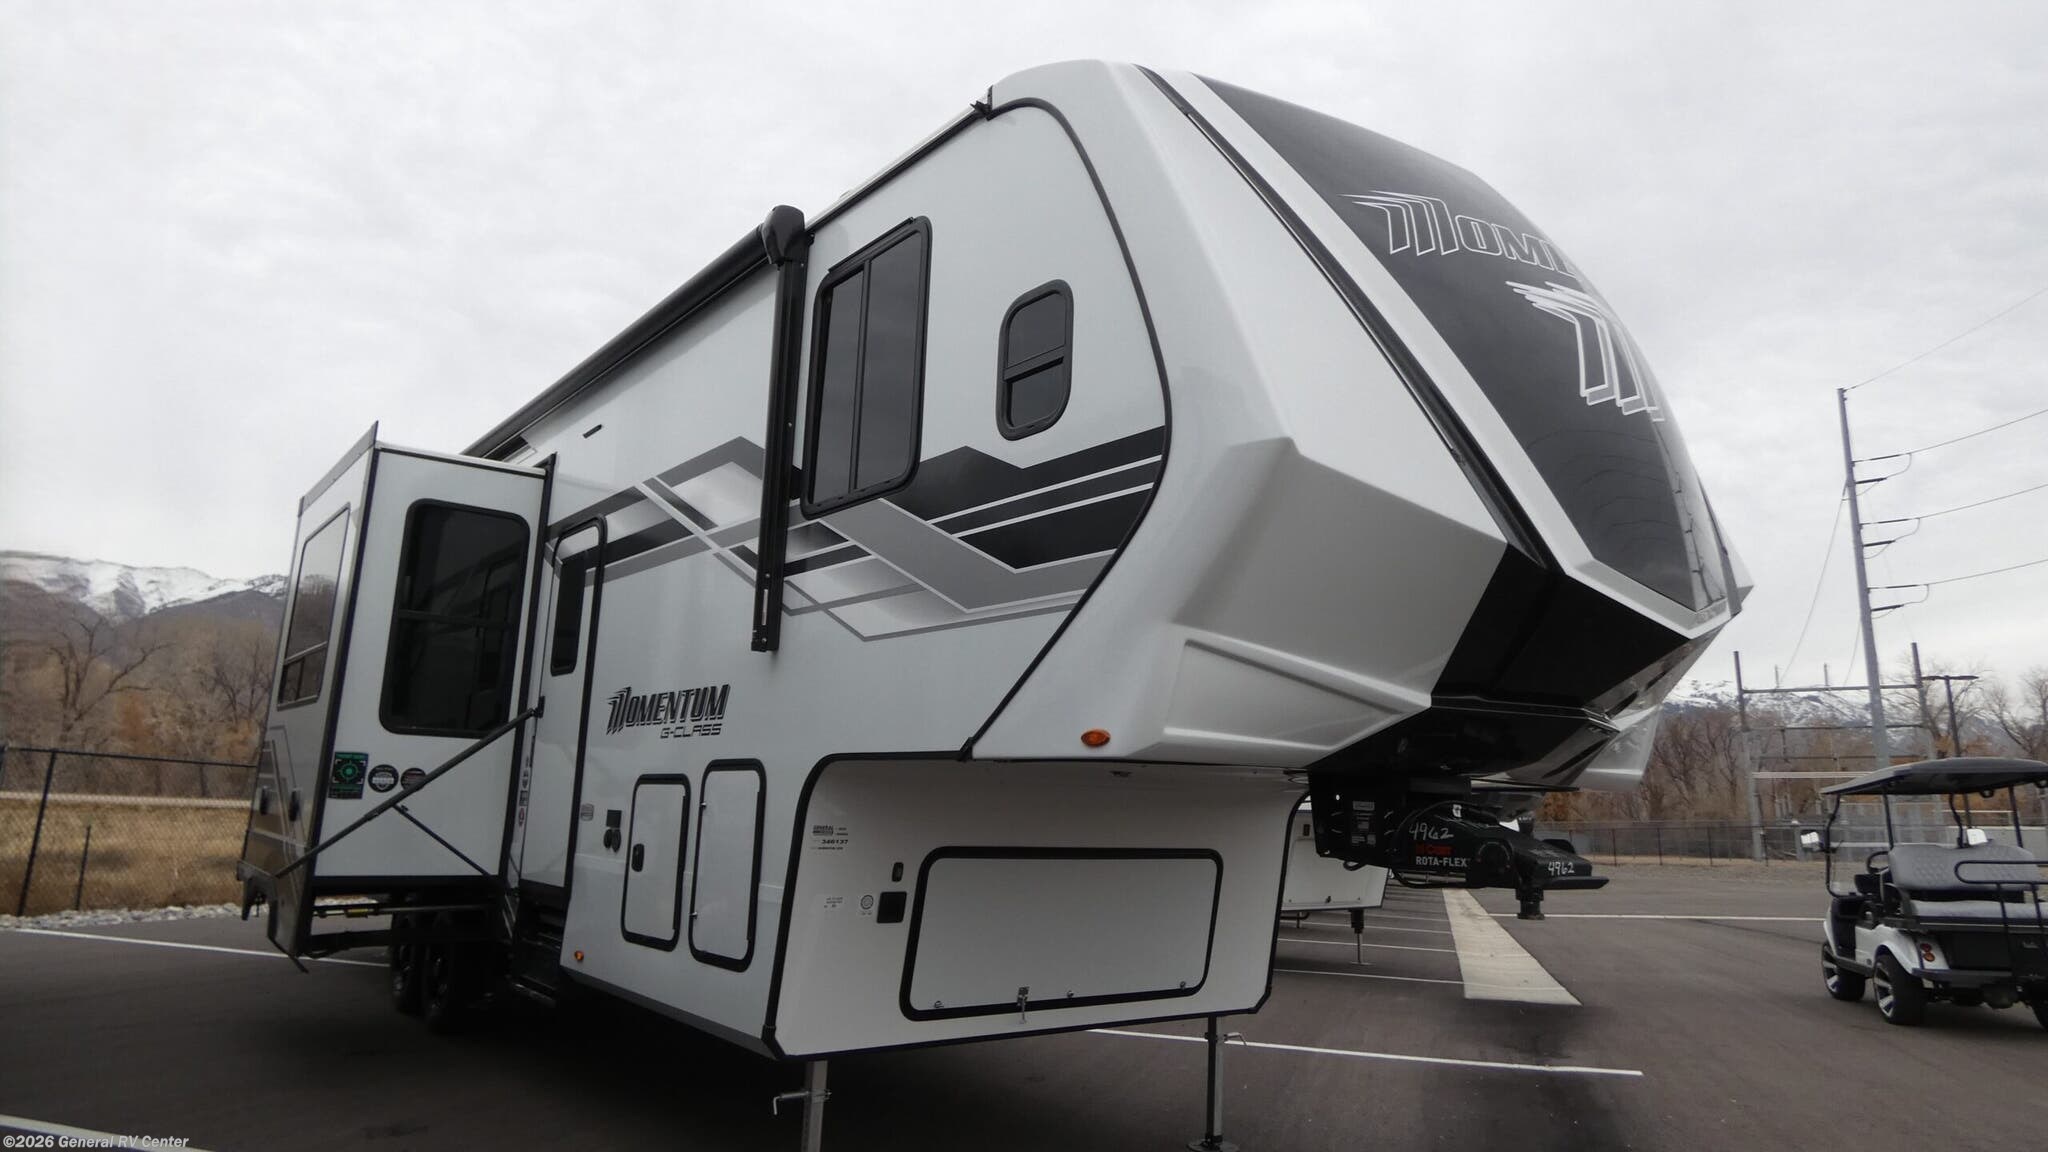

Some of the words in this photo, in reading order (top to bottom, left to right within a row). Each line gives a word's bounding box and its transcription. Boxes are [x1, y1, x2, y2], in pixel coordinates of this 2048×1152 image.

[606, 683, 731, 736] MOMENTUM
[660, 723, 723, 739] G-CLASS
[1408, 822, 1454, 841] 4962
[1415, 856, 1468, 867] ROTA-FLEX
[1547, 860, 1575, 876] 4962
